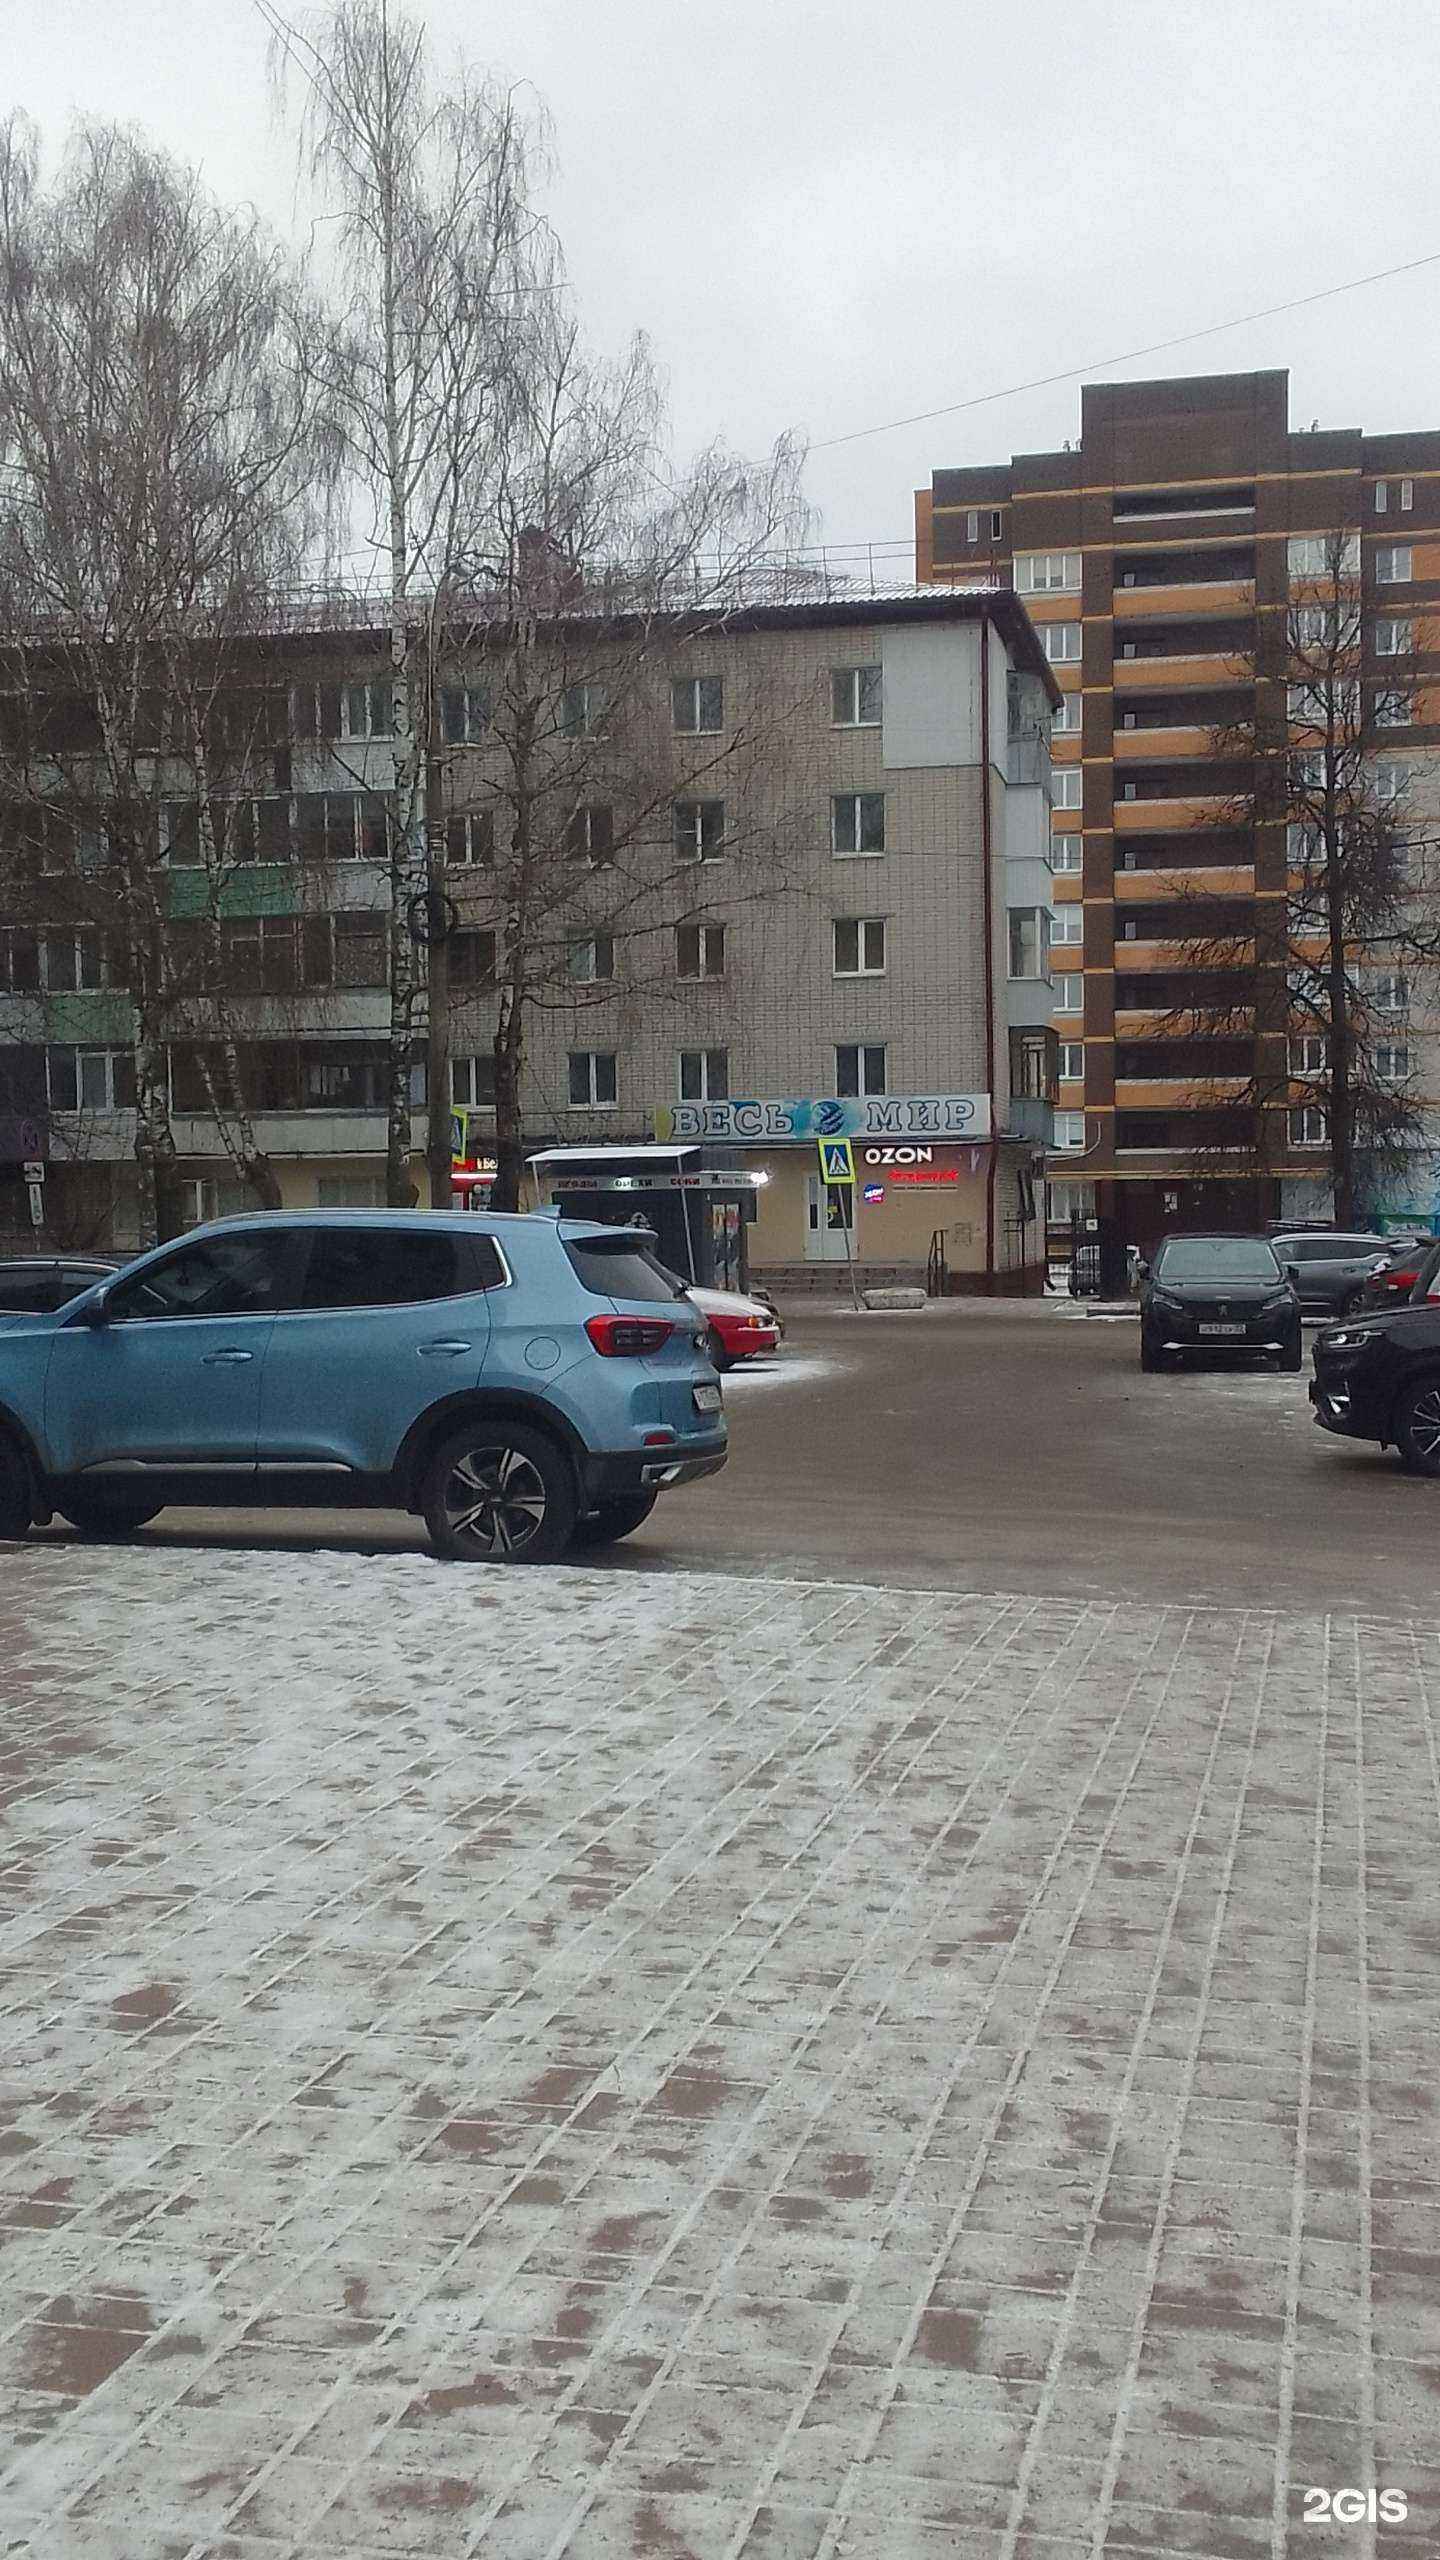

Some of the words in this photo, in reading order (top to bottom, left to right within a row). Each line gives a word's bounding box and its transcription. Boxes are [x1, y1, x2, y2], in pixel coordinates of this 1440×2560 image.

[670, 1101, 794, 1137] ВЕСЬ
[867, 1099, 975, 1133] МИР
[864, 1146, 933, 1165] OZON
